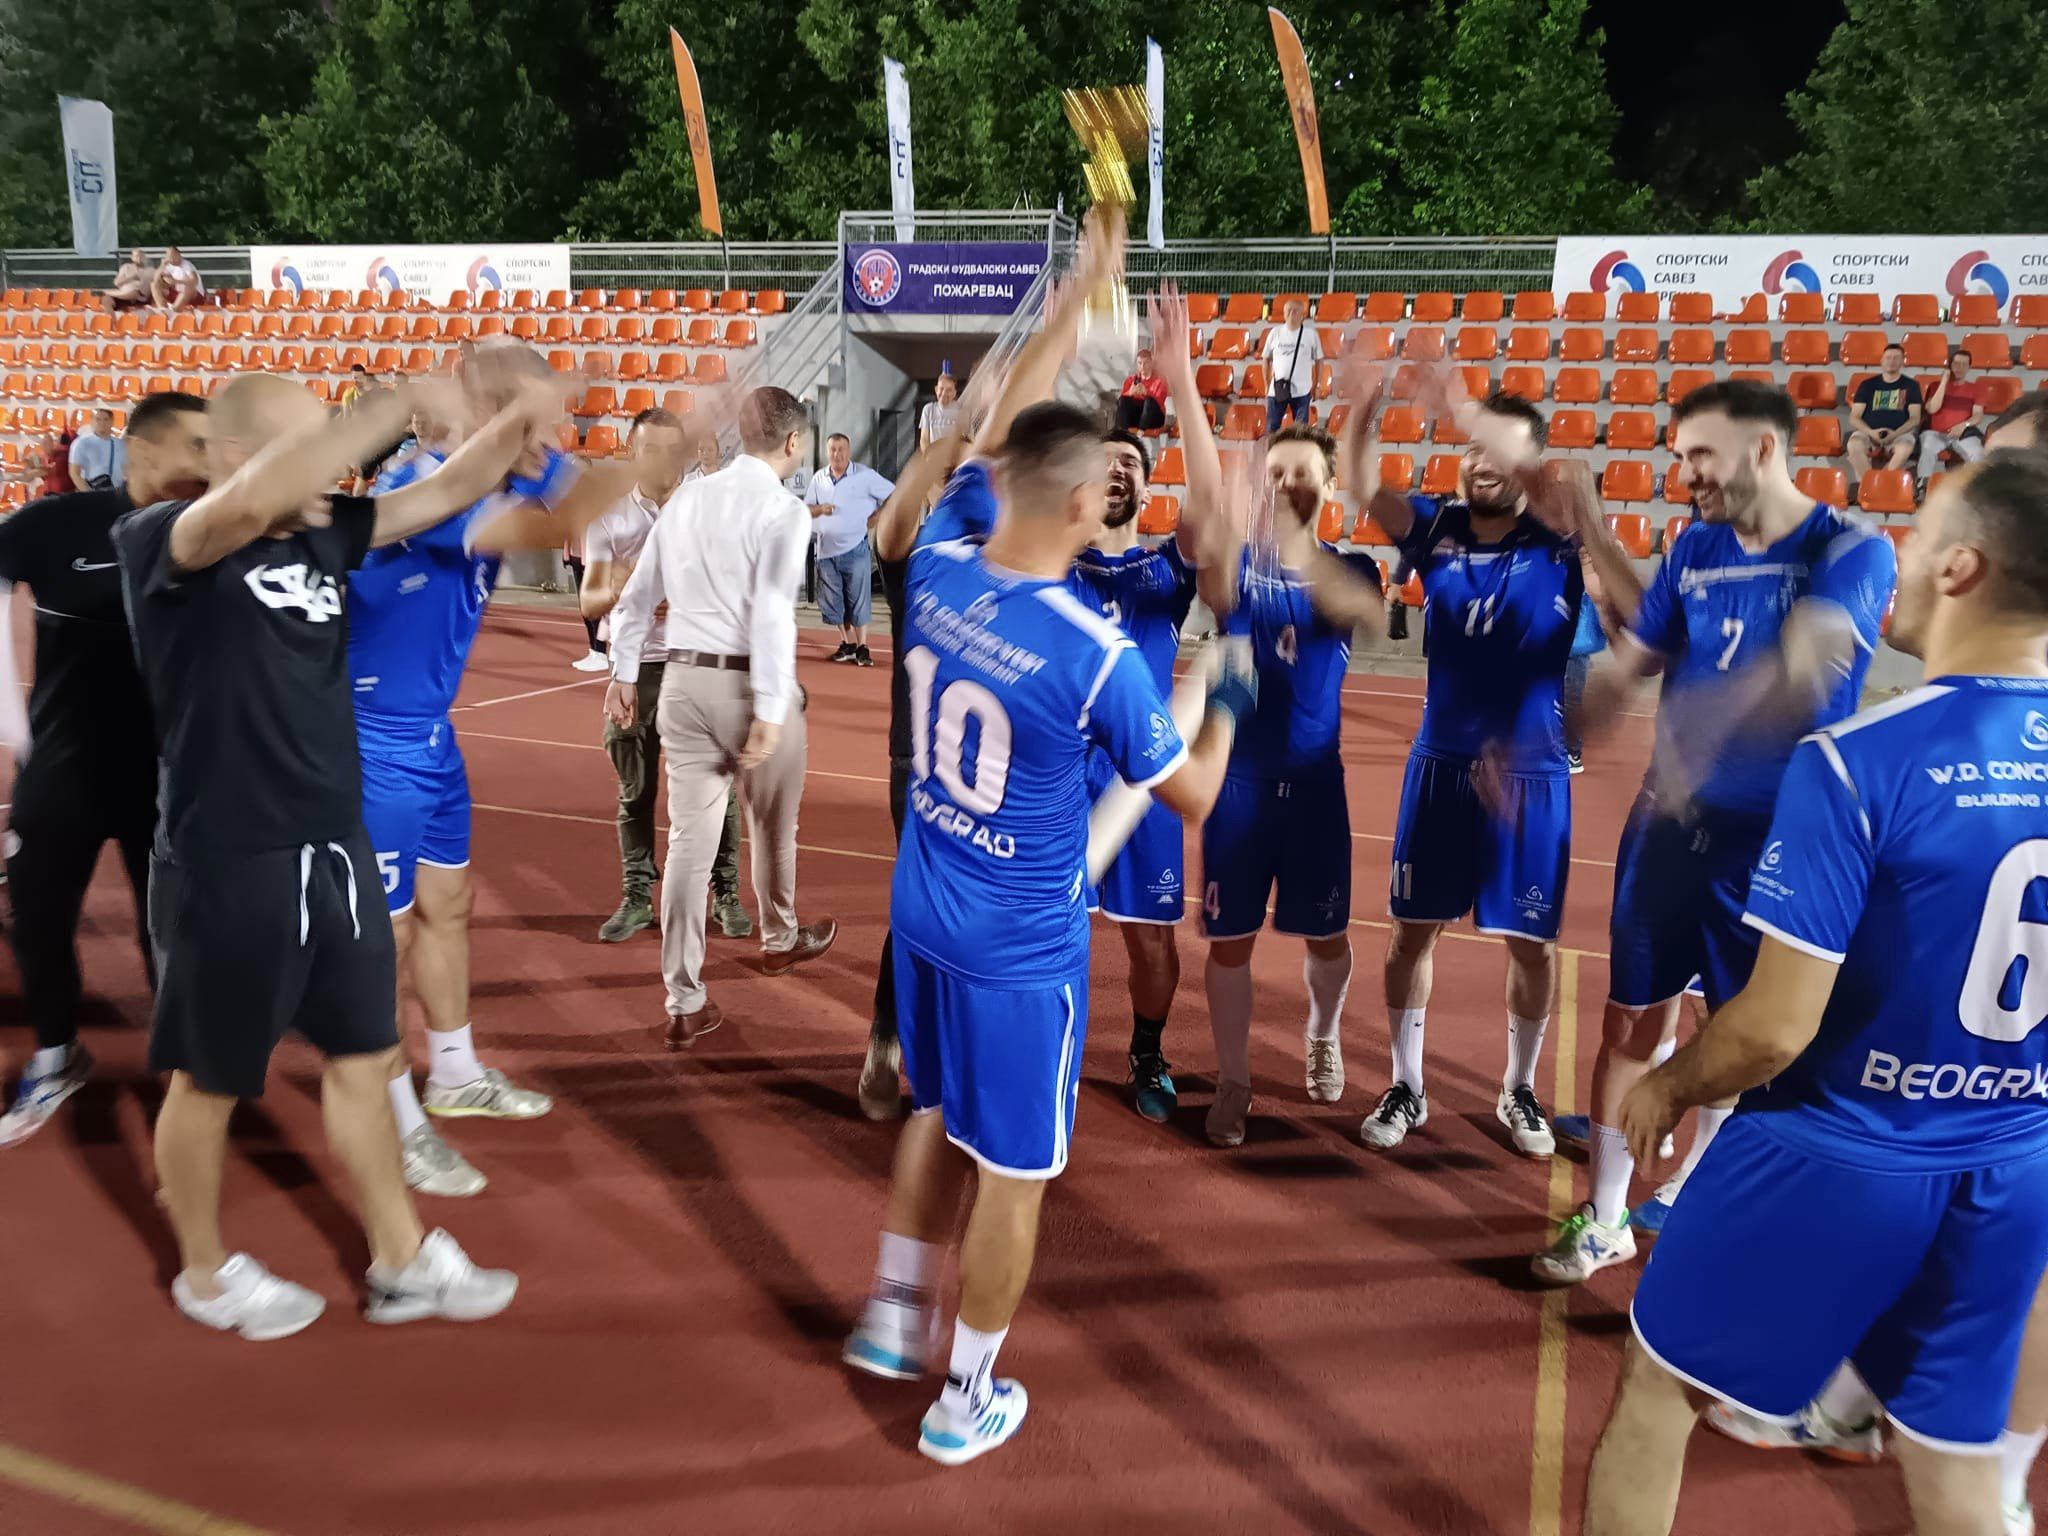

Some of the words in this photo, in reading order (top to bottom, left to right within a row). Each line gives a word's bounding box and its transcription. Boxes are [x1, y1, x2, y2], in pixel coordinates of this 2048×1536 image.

[506, 259, 551, 268] СПОРТСКИ
[1656, 254, 1728, 265] СПОРТСКИ
[1832, 254, 1909, 266] СПОРТСКИ
[909, 264, 949, 275] ГРАДСКИ
[952, 264, 1007, 275] ФУДБАЛСКИ
[1010, 264, 1040, 274] САВЕЗ
[1654, 272, 1695, 284] САВЕЗ
[1830, 273, 1874, 285] САВЕЗ
[933, 284, 1013, 299] ПОЖАРЕВАЦ
[1464, 593, 1496, 637] 11
[1716, 617, 1744, 670] 7
[903, 644, 1012, 815] 10
[1987, 761, 2048, 782] CONC
[1205, 881, 1220, 920] 4
[1958, 838, 2048, 1042] 6
